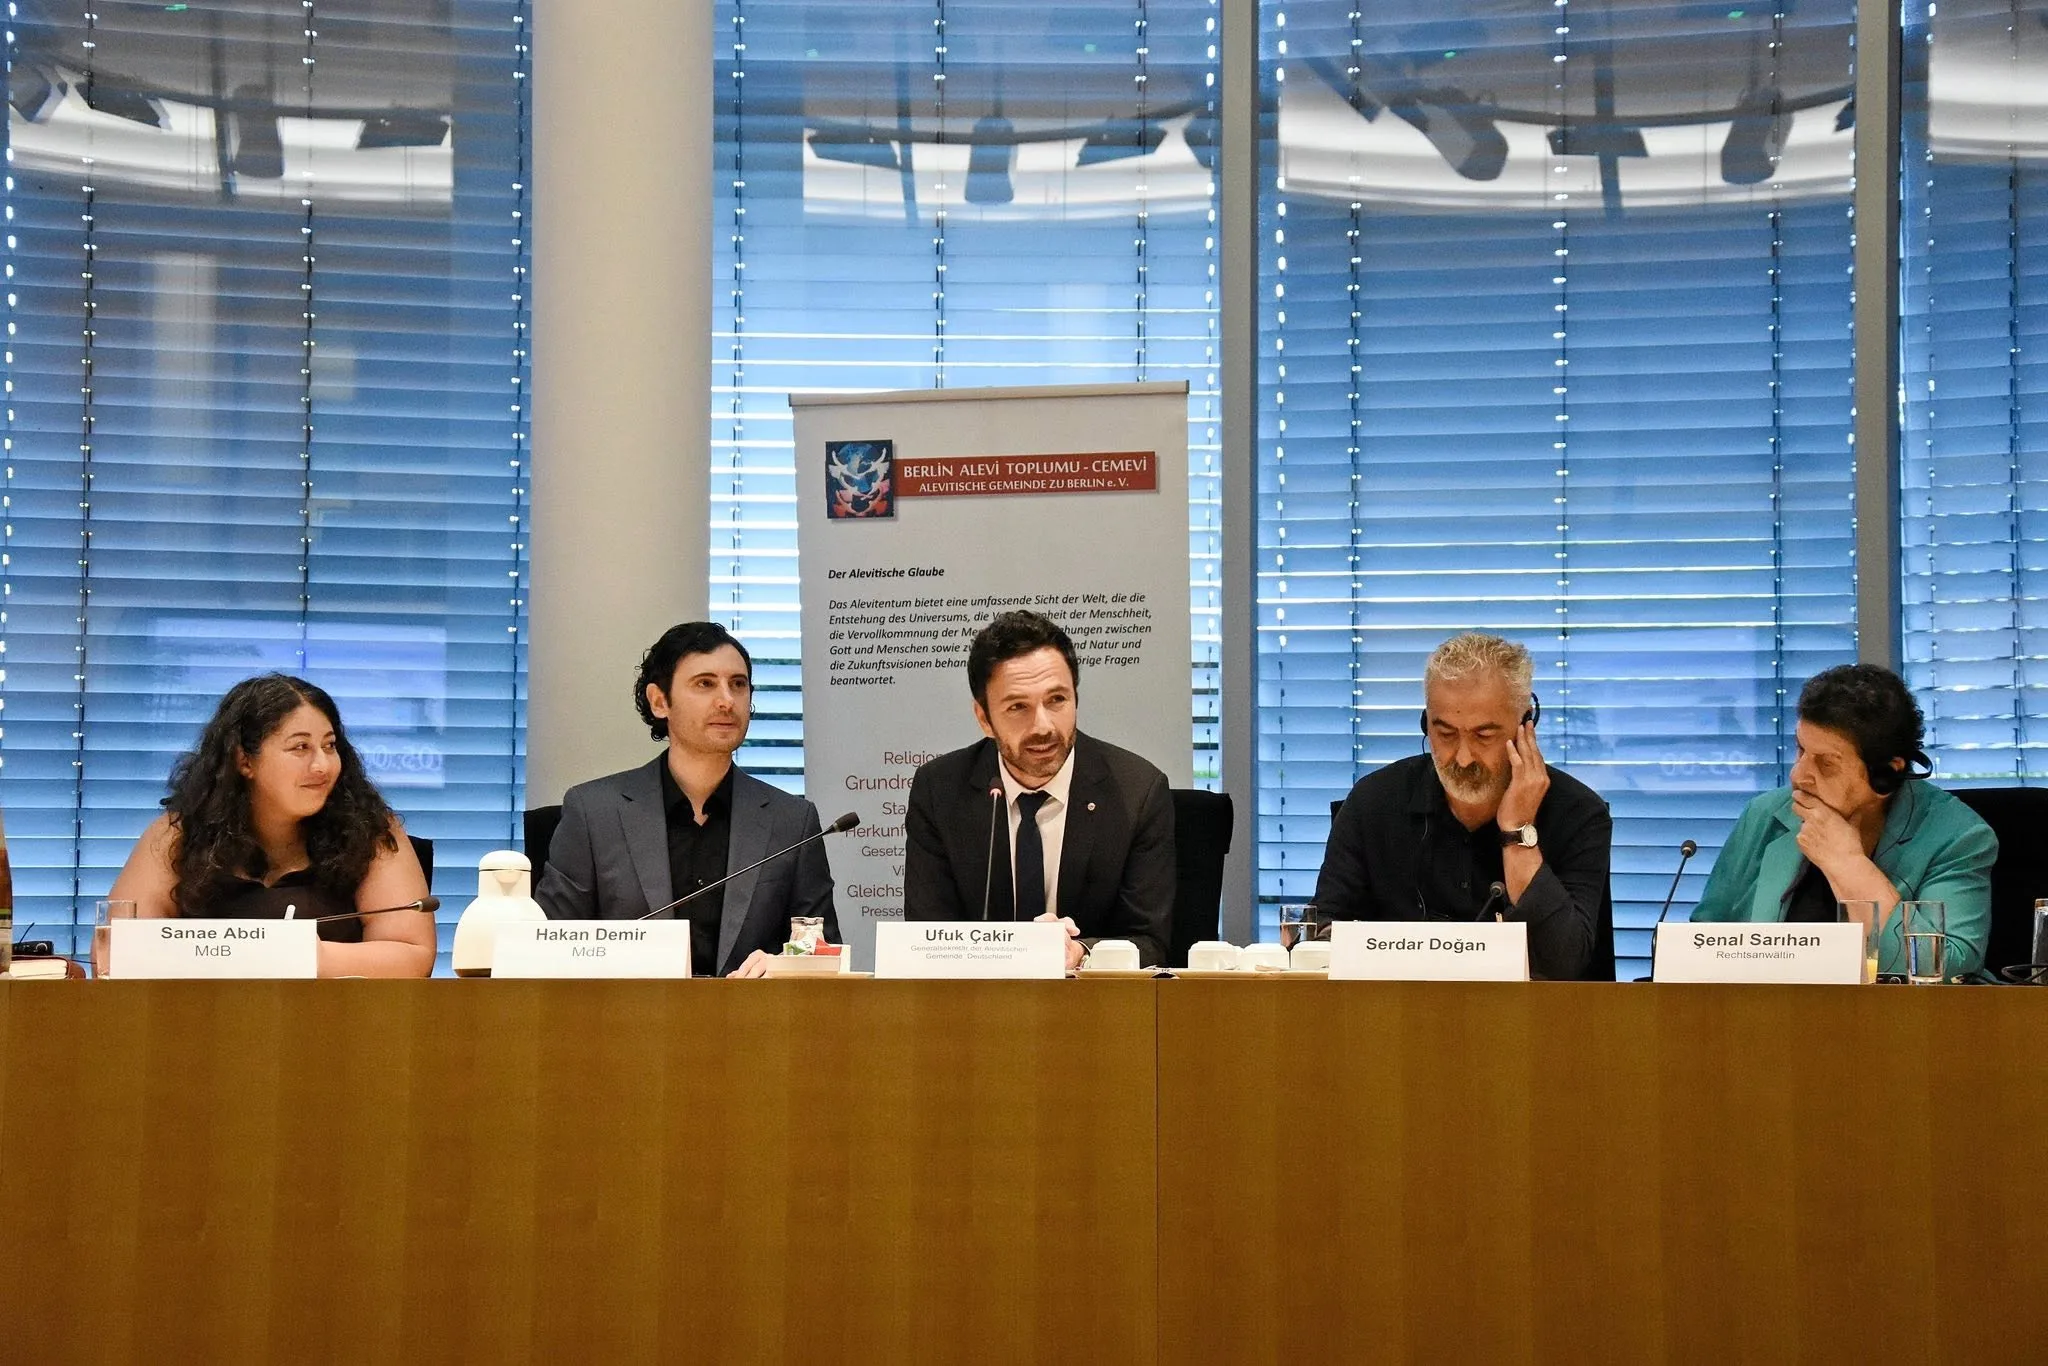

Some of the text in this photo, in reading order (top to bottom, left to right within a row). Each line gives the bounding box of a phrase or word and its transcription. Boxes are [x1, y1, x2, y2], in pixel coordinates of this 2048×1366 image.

[1006, 461, 1080, 476] TOPLUMU
[919, 477, 1129, 493] ALEVITISCHE GEMEINDE ZU BERLIN e. V.
[828, 566, 945, 579] Der Alevitische Glaube
[829, 592, 1146, 609] Das Alevitentum bietet eine umfassende Sicht der Welt, die die
[829, 614, 886, 626] Entstehung
[888, 613, 906, 624] des
[909, 612, 971, 624] Universums,
[974, 611, 990, 622] die
[1069, 609, 1087, 619] der
[1089, 608, 1152, 620] Menschheit,
[829, 629, 845, 640] die
[847, 628, 939, 640] Vervollkommnung
[941, 627, 959, 638] der
[1105, 623, 1152, 634] zwischen
[829, 645, 852, 655] Gott
[854, 644, 874, 655] und
[876, 643, 929, 654] Menschen
[931, 642, 961, 653] sowie
[1073, 638, 1142, 650] nd Natur und
[829, 657, 968, 671] die Zukunftsvisionen behan
[1104, 654, 1140, 667] Fragen
[830, 675, 896, 686] beantwortet.
[884, 750, 944, 768] Religio
[845, 774, 915, 791] Grundre
[882, 801, 907, 815] Sta
[892, 865, 905, 876] Vi
[847, 884, 905, 898] Gleichs
[161, 926, 265, 940] Sanae Abdi
[536, 928, 647, 941] Hakan Demir
[925, 929, 1015, 944] Ufuk Çakir
[1366, 937, 1487, 954] Serdar Doğan
[1693, 933, 1821, 950] Şenal Sarıhan
[195, 945, 232, 957] MdB
[572, 946, 607, 957] MdB
[925, 952, 1013, 960] Gemeinde Deutschland
[1716, 950, 1796, 960] Rechtsanwältin
